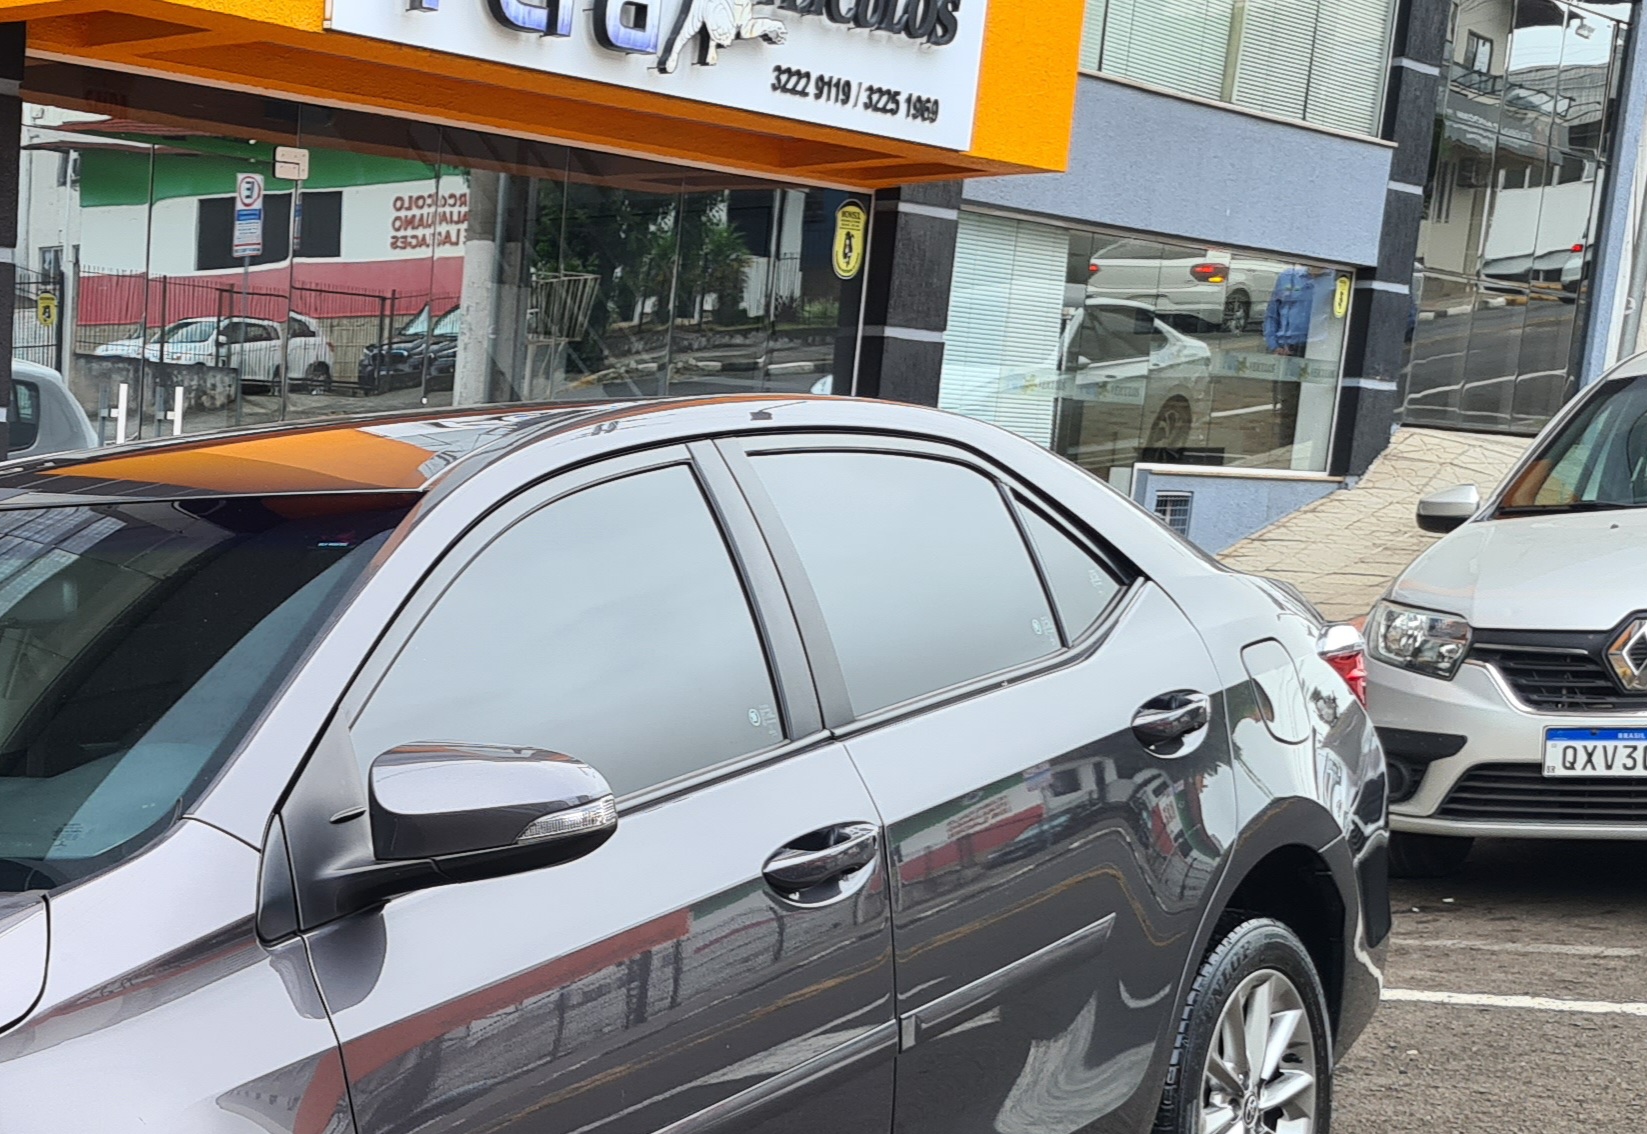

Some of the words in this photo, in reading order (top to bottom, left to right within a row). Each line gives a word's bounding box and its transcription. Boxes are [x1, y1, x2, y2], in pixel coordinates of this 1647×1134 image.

[771, 65, 811, 97] 3222
[814, 74, 852, 106] 9119
[863, 85, 901, 116] 3225
[904, 93, 939, 123] 1969
